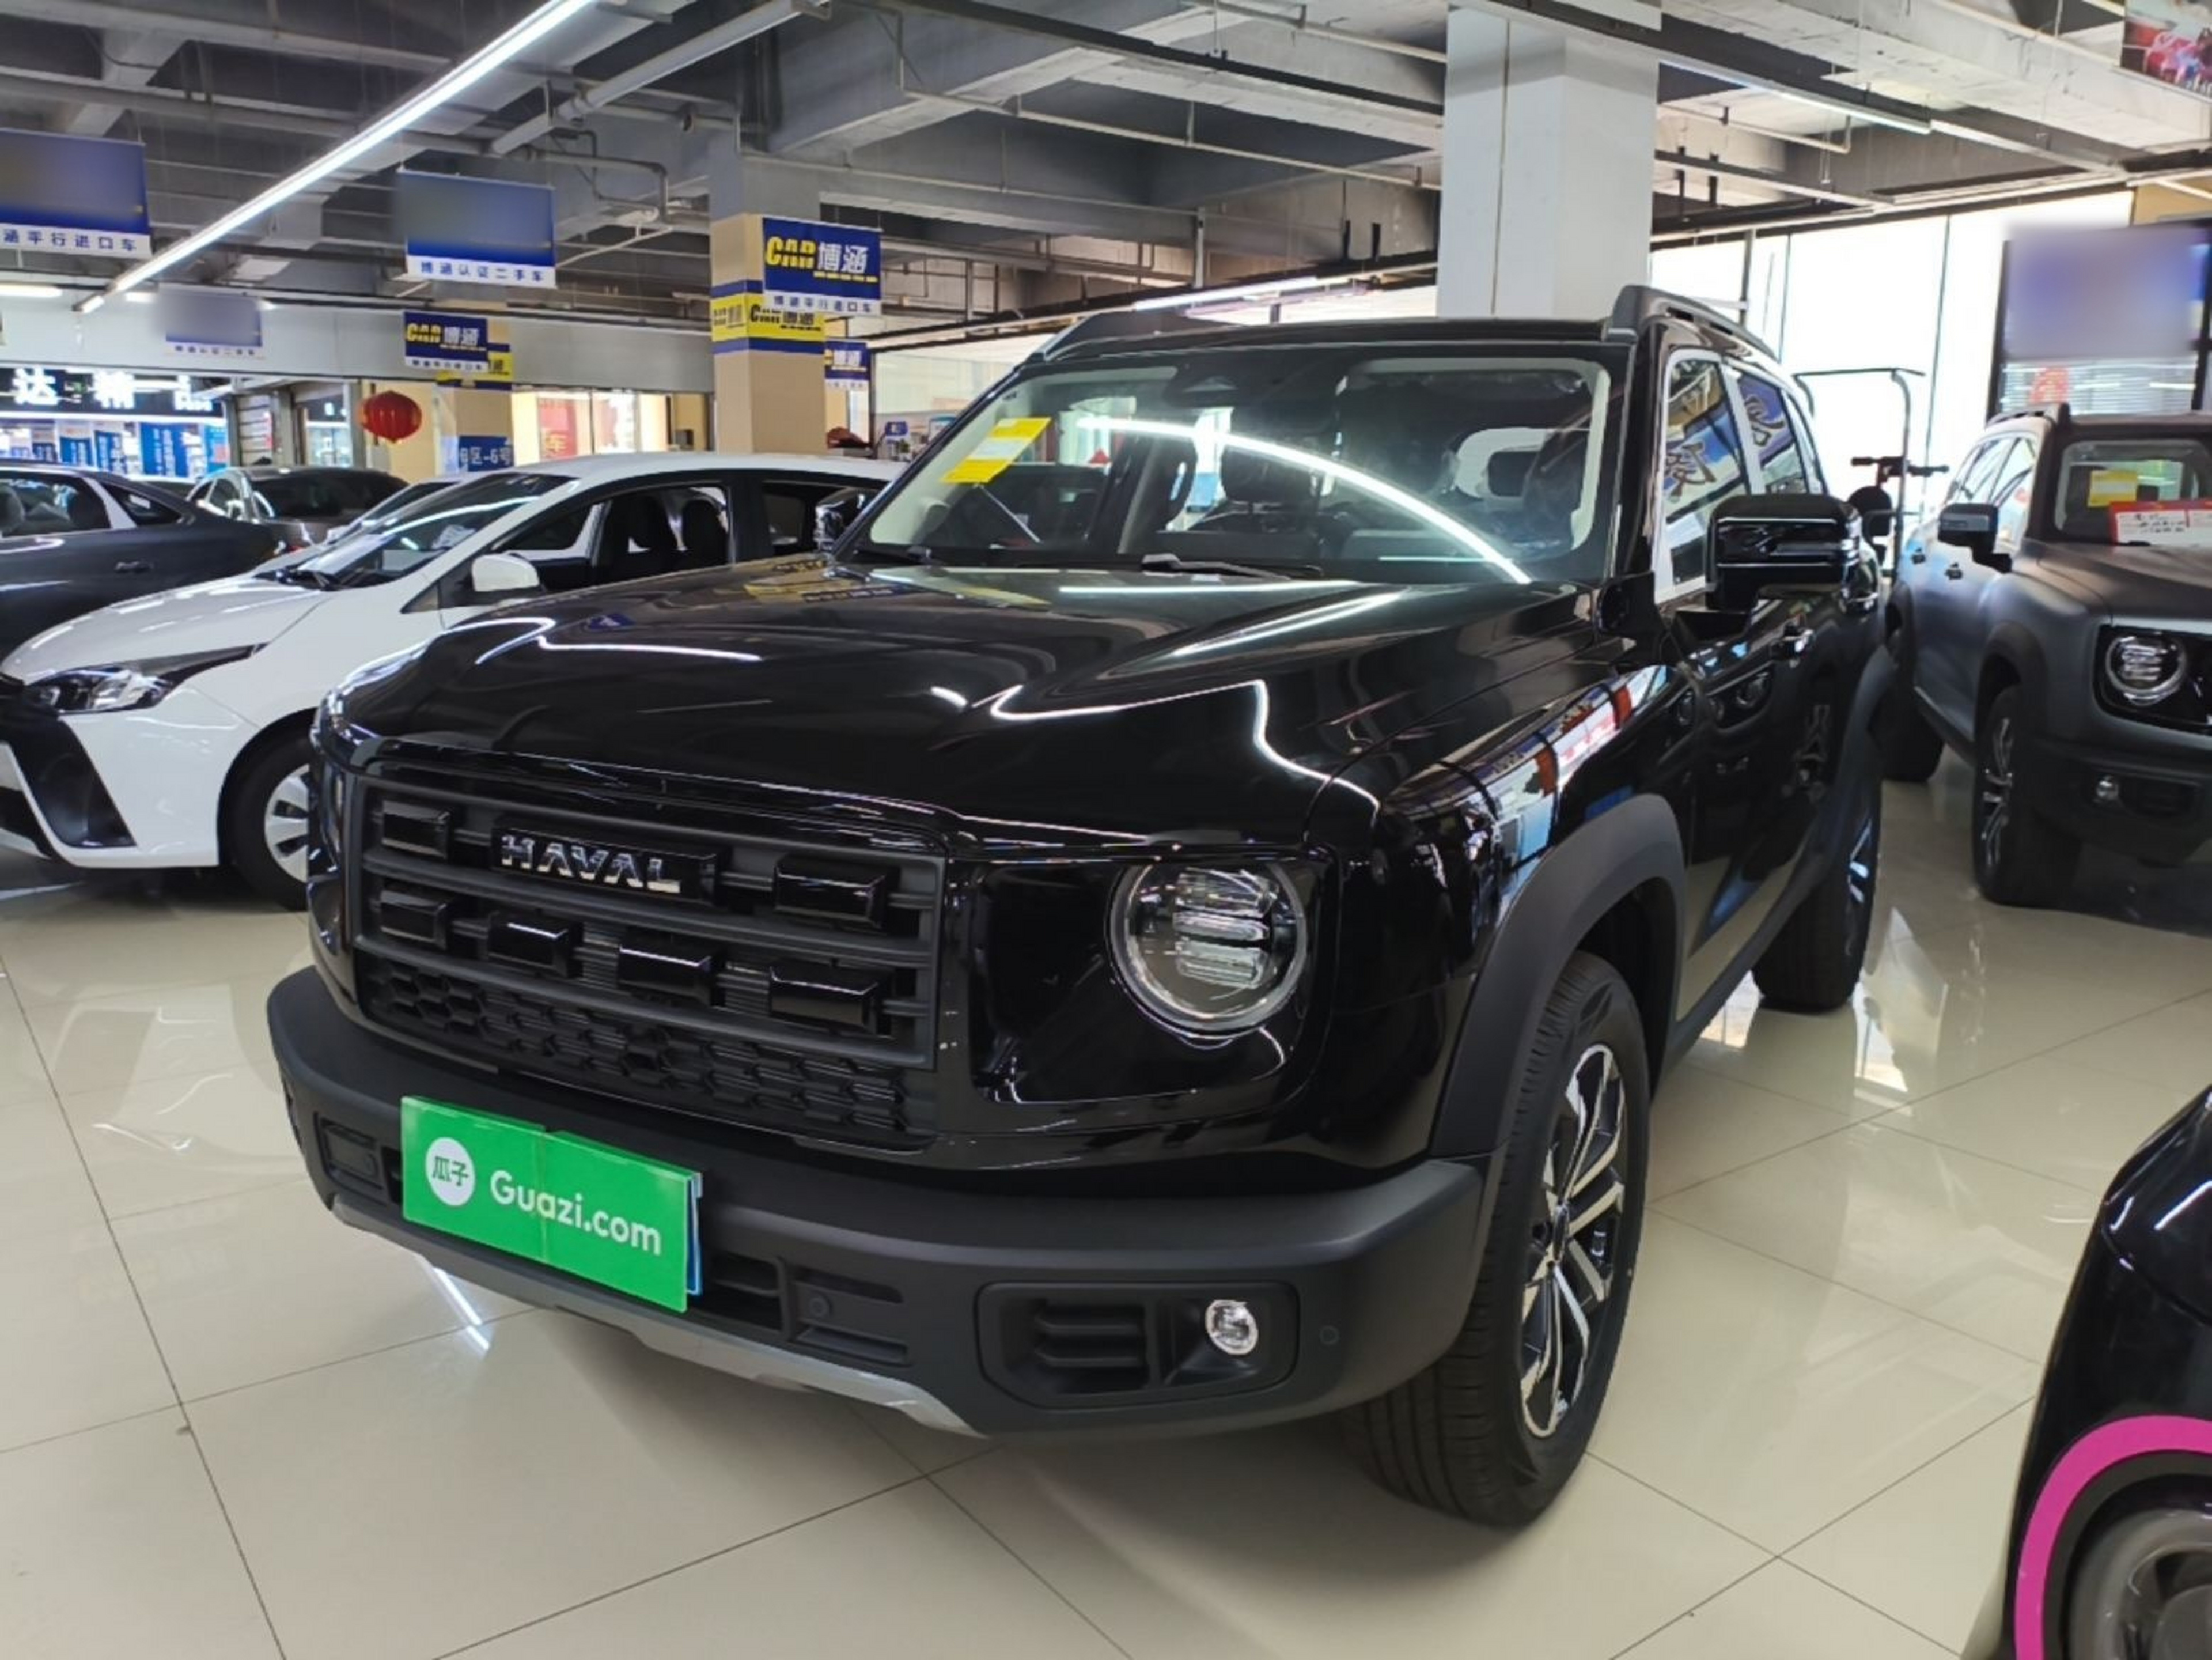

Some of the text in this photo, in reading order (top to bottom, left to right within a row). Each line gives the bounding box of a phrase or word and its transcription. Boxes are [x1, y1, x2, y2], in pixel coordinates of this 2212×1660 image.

[766, 236, 816, 269] CAR
[502, 835, 681, 893] HAVAL
[432, 1156, 469, 1186] 瓜子
[490, 1169, 661, 1256] Guazi.com
